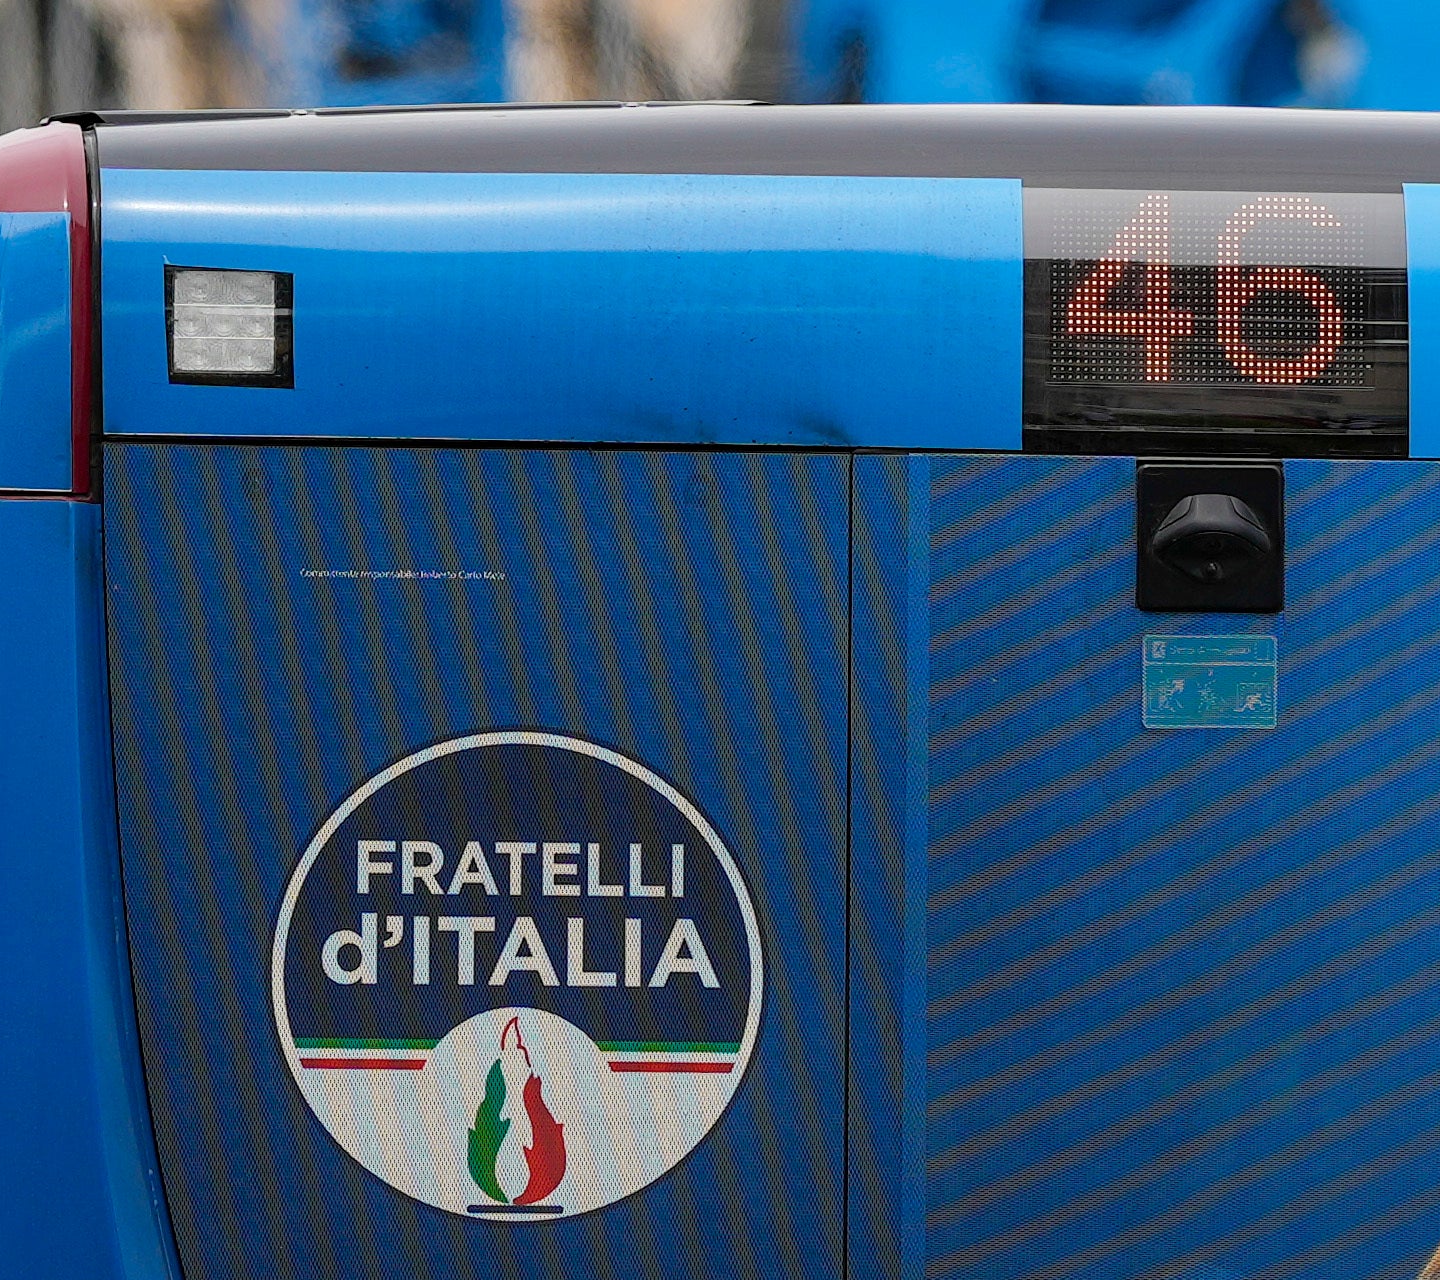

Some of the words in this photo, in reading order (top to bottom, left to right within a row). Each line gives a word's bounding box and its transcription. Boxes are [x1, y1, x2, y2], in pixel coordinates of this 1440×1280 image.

[1067, 194, 1343, 383] 46
[356, 841, 685, 898] FRATELLI
[321, 912, 720, 989] d'ITALIA
